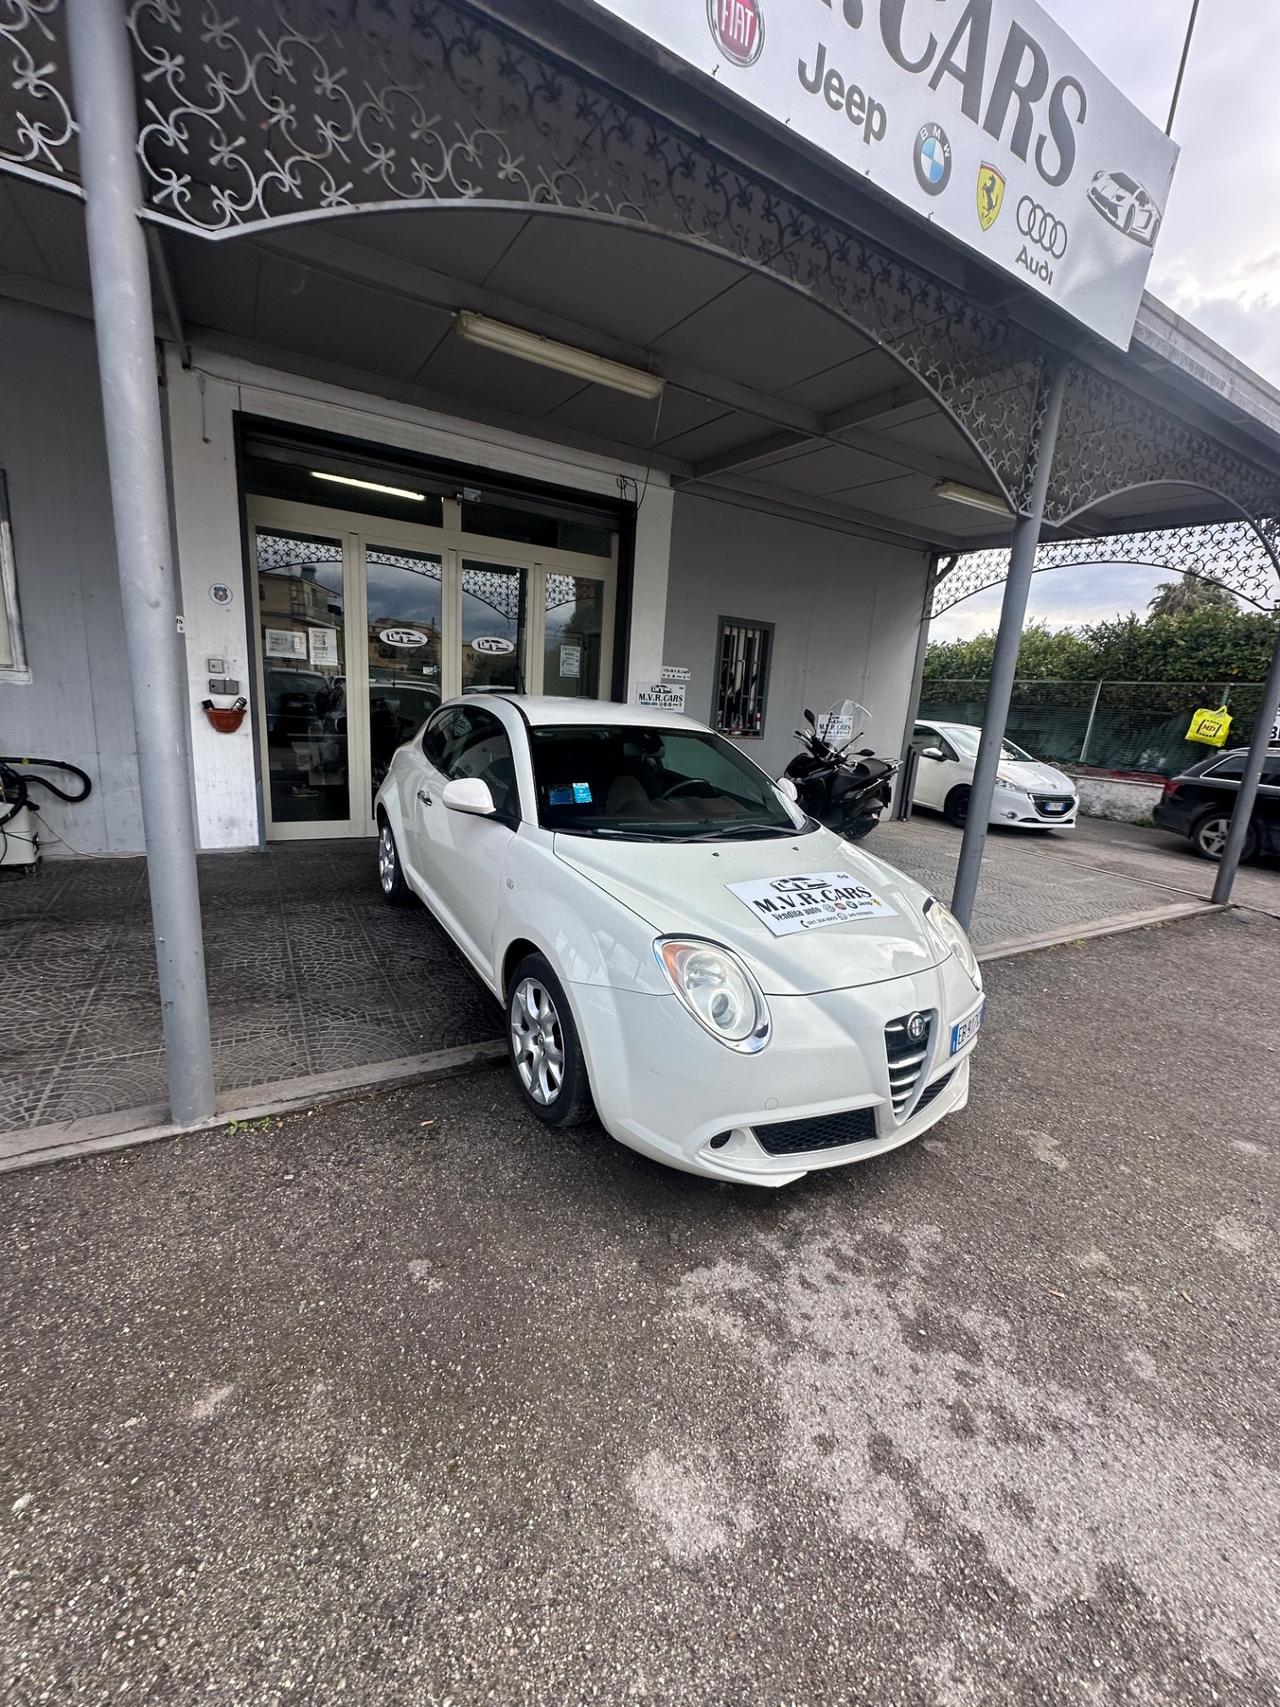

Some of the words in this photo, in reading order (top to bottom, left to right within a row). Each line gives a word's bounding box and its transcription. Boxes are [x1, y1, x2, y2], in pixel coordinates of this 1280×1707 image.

[721, 0, 753, 47] FIAT
[797, 41, 887, 146] Jeep
[920, 125, 952, 158] BMW
[1014, 244, 1054, 286] Audi
[1201, 723, 1216, 732] MD
[753, 886, 872, 914] M.V.R.CARS
[771, 910, 805, 921] Vendita
[803, 907, 822, 915] auto
